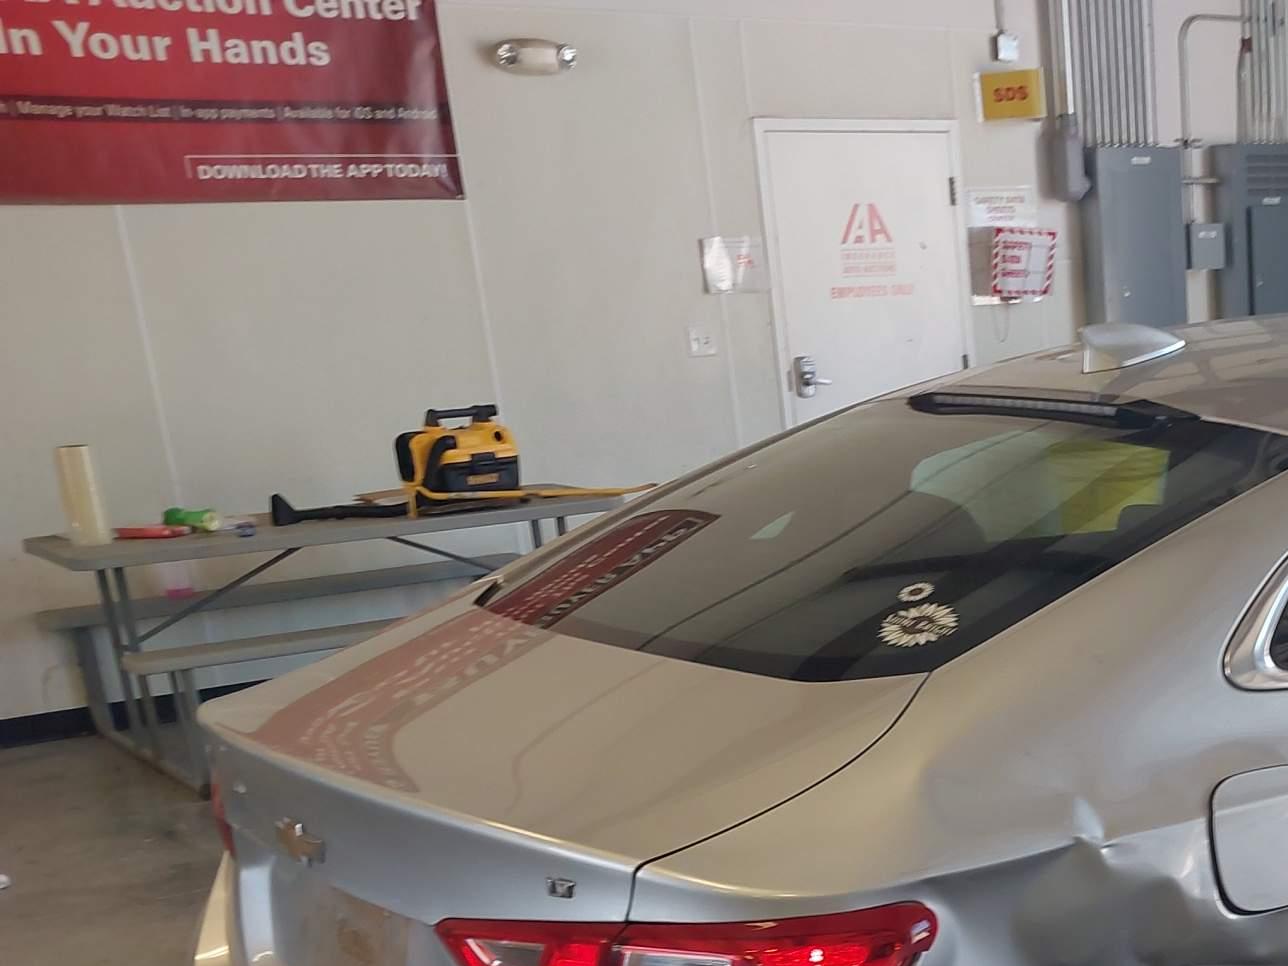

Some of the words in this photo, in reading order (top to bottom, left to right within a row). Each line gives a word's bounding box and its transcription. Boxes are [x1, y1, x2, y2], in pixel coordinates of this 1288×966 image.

[52, 20, 172, 61] Your
[186, 28, 331, 66] Hands
[993, 85, 1029, 103] SDS
[196, 163, 307, 180] DOWNLOAD
[307, 163, 343, 179] THE
[346, 164, 384, 178] APP
[384, 163, 448, 179] TODAY!
